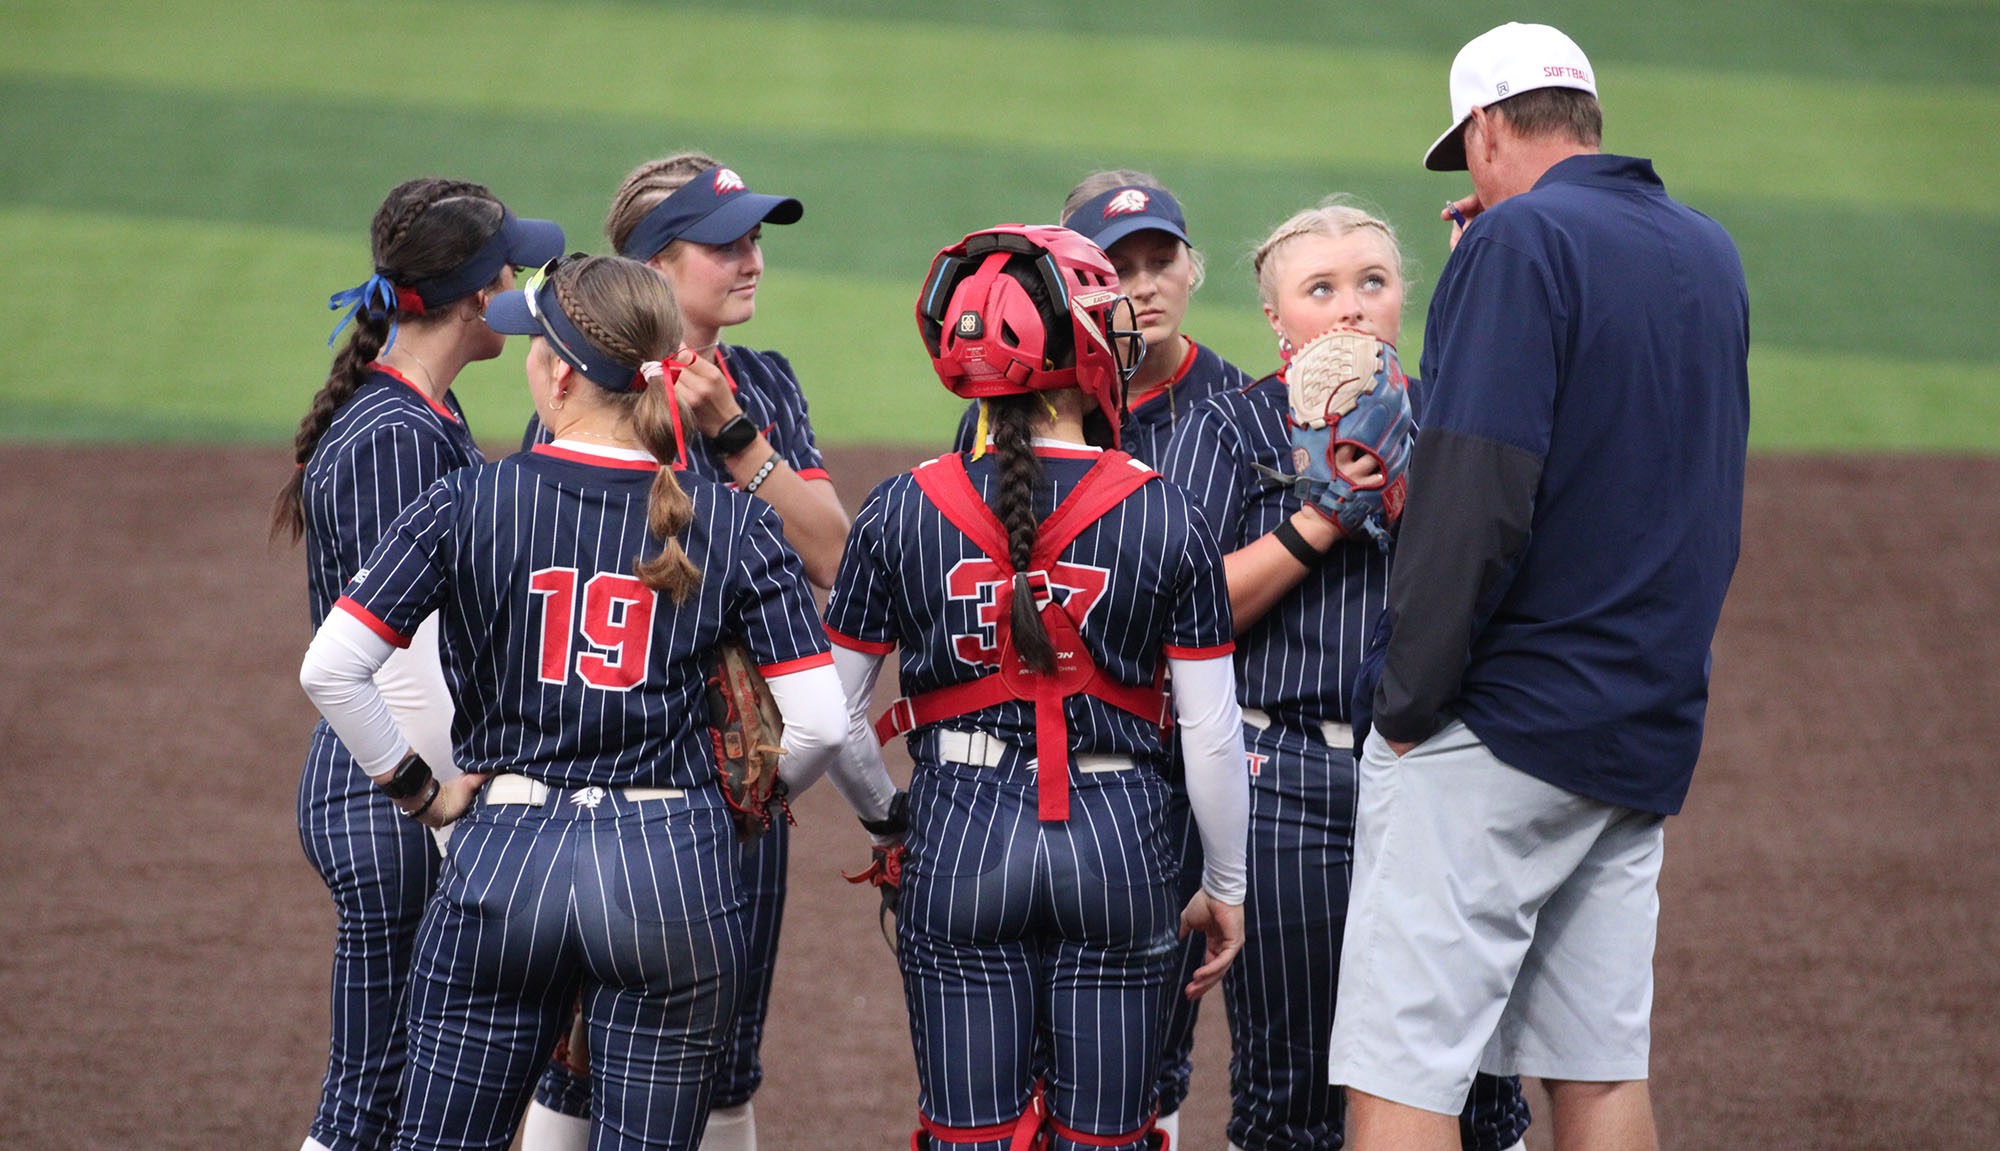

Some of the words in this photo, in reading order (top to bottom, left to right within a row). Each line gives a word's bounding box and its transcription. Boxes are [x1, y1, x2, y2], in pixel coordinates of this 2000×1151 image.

[1543, 66, 1591, 84] SOFTBALL
[529, 566, 658, 692] 19
[946, 558, 1111, 669] 37
